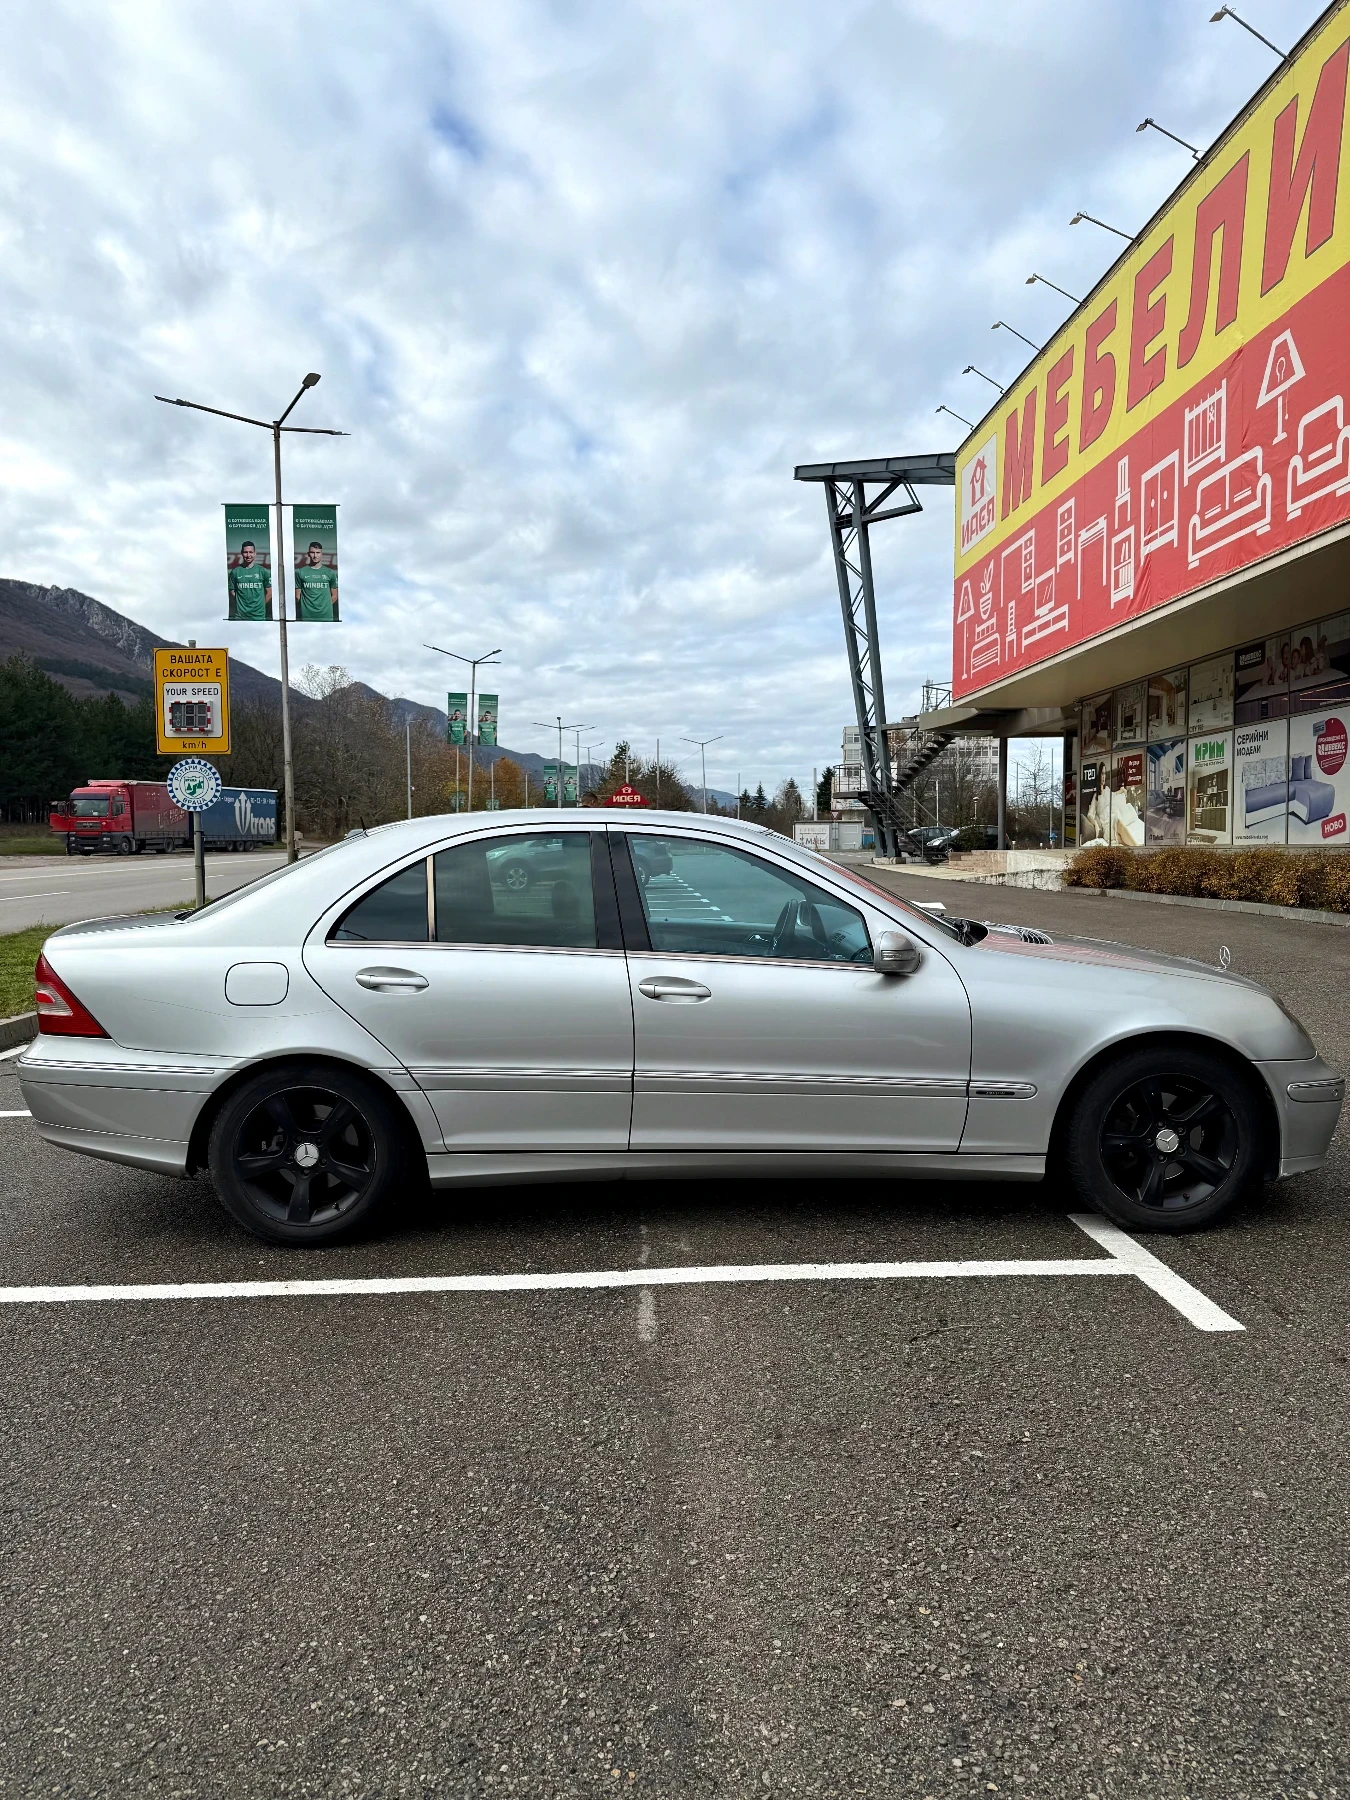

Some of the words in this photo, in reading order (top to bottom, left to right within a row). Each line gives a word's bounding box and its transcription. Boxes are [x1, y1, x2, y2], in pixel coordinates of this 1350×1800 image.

[1001, 36, 1350, 522] МЕБЕЛИ
[961, 495, 995, 548] ИДЕЯ
[170, 654, 213, 664] ВАШАТА
[162, 668, 211, 678] СКОРОСТ
[215, 668, 222, 677] Е
[165, 687, 188, 696] YOUR
[191, 687, 219, 696] SPEED
[1236, 729, 1269, 745] СЕРИЙНИ
[182, 741, 207, 749] km/h
[1194, 740, 1225, 761] ИРИМ
[175, 765, 198, 781] РОТАРИ
[199, 767, 214, 782] КЛУБ
[612, 795, 641, 803] ИДЕЯ
[250, 812, 276, 835] trans
[1324, 819, 1344, 833] НОВО
